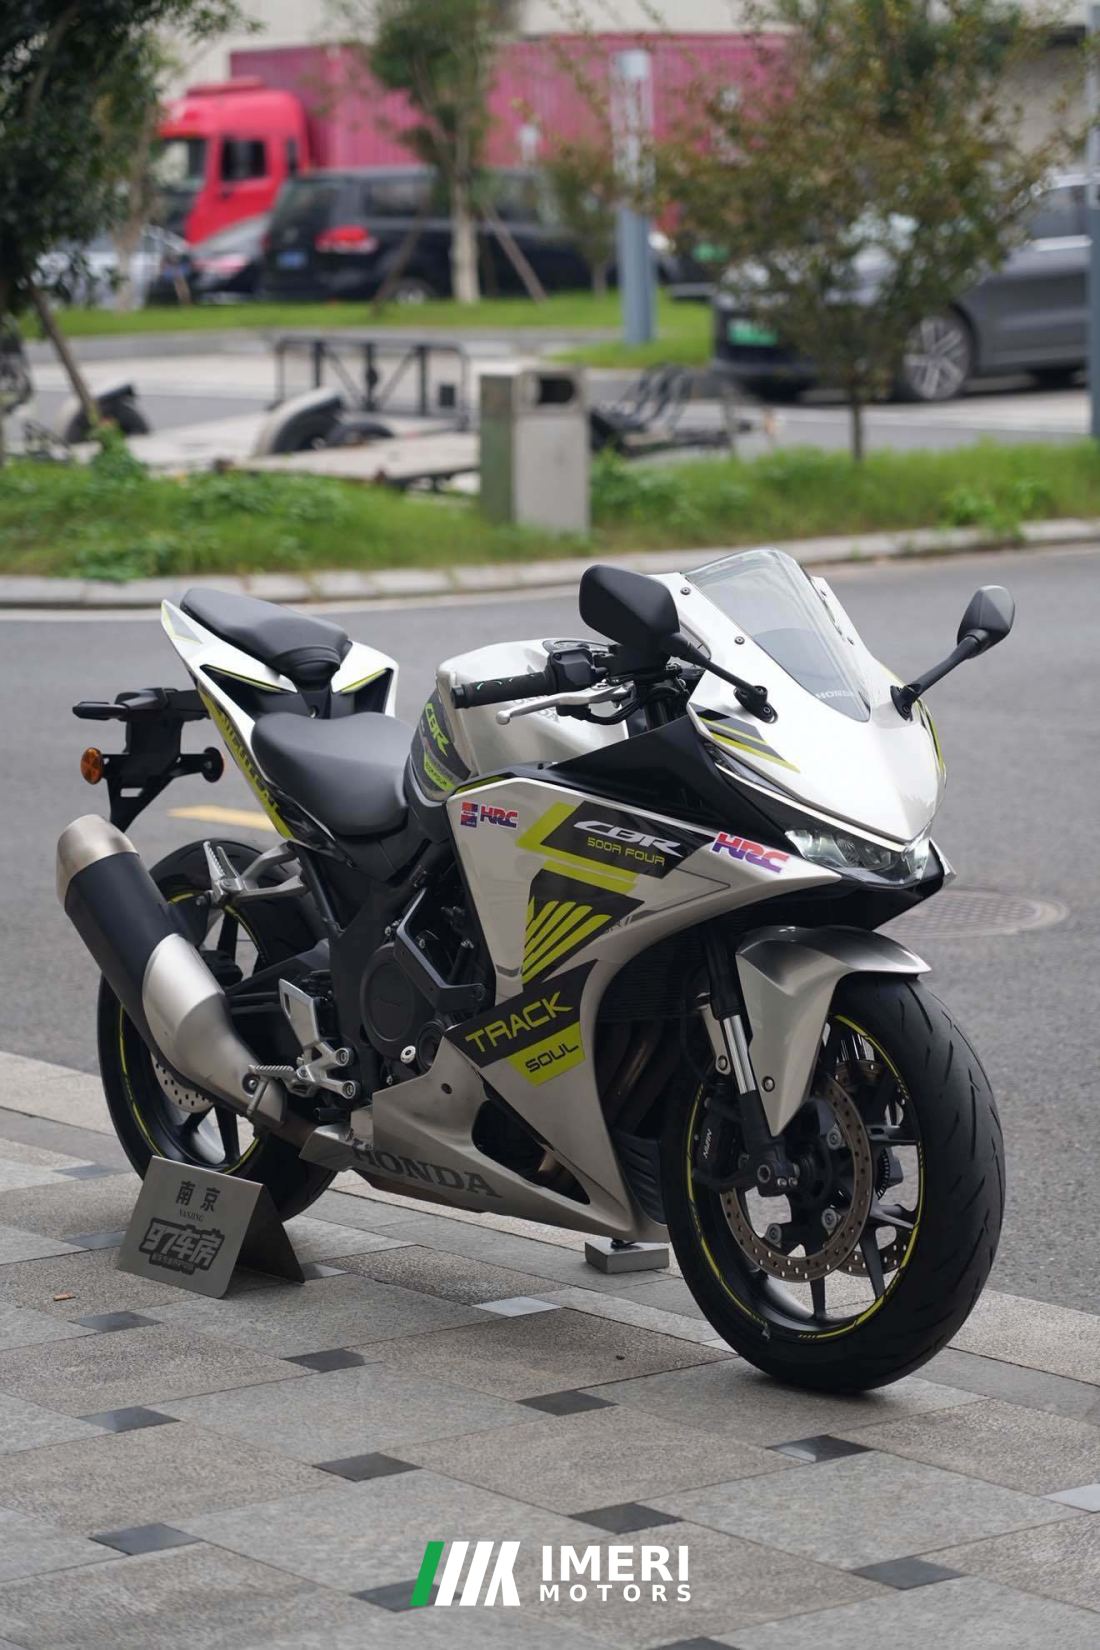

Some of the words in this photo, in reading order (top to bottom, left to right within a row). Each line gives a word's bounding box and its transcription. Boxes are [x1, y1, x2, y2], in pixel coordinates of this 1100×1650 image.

[480, 805, 518, 828] HRC
[574, 820, 683, 858] CBR
[587, 836, 622, 854] 500R
[625, 848, 665, 866] FOUR
[712, 832, 789, 873] HRC
[465, 991, 574, 1052] TRACK
[525, 1042, 579, 1073] SOUL
[352, 1148, 504, 1198] HONDA
[175, 1181, 221, 1212] 南京
